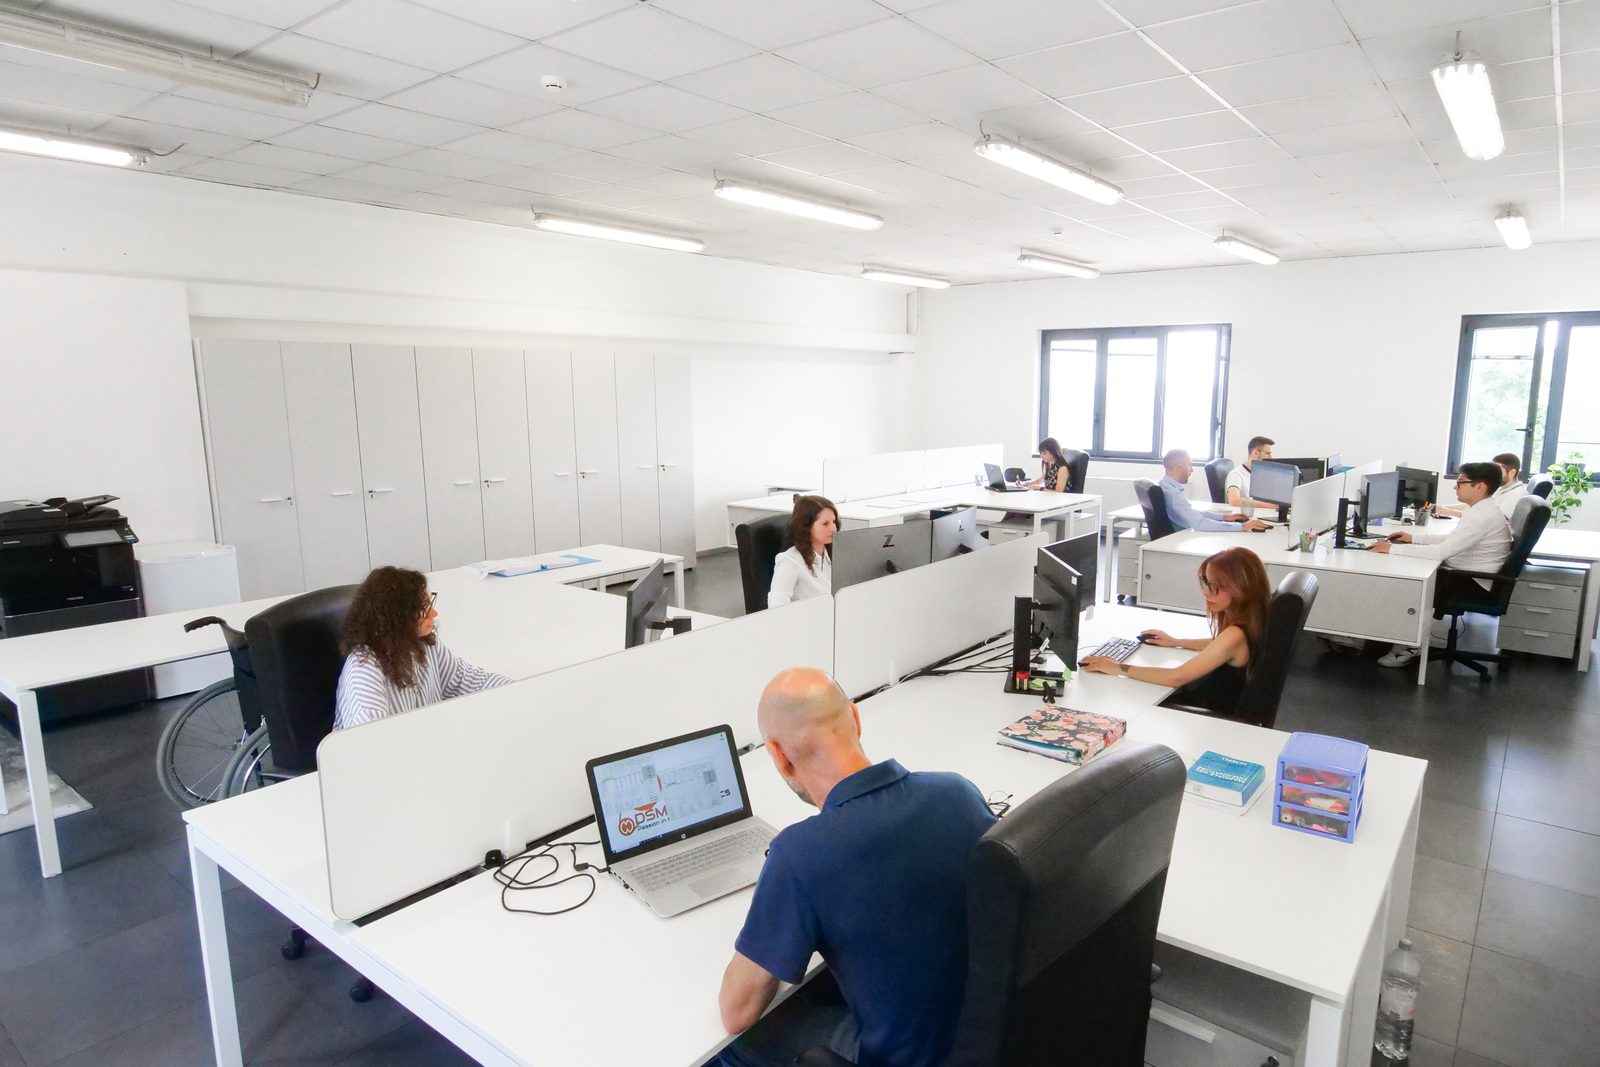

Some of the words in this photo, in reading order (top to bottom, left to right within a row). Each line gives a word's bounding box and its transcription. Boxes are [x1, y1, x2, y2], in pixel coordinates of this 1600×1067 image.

[882, 534, 895, 548] Z
[634, 805, 668, 825] DSM
[637, 820, 661, 831] Passion
